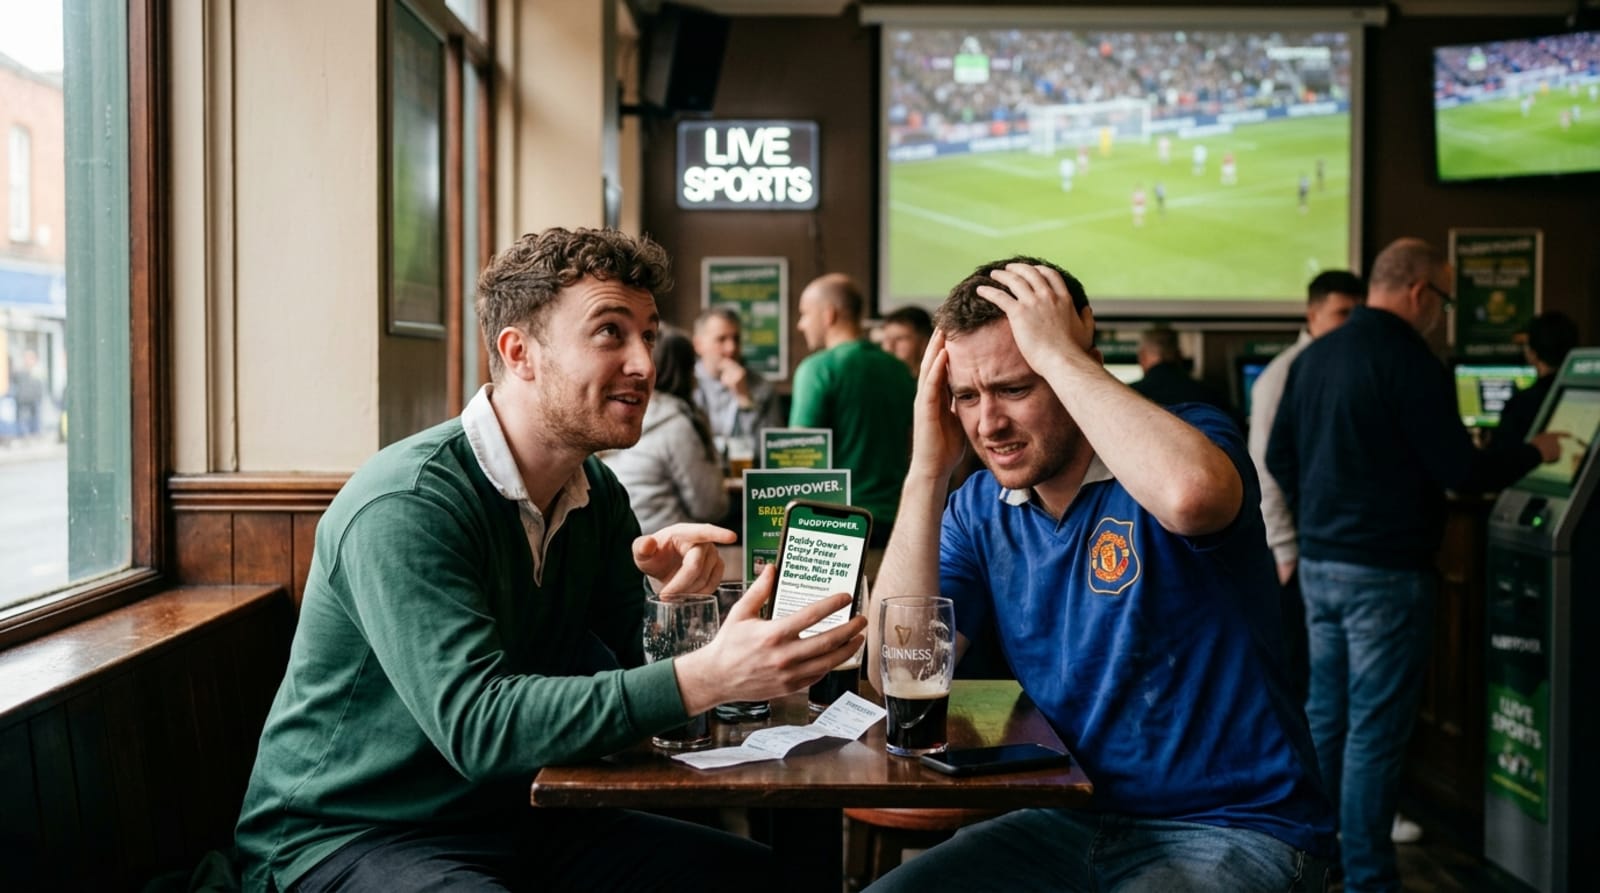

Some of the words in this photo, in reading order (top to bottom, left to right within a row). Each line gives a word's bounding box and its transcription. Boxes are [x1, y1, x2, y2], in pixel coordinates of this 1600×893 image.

[705, 127, 791, 165] LIVE
[683, 166, 813, 202] SPORTS
[882, 645, 932, 661] GUINNESS
